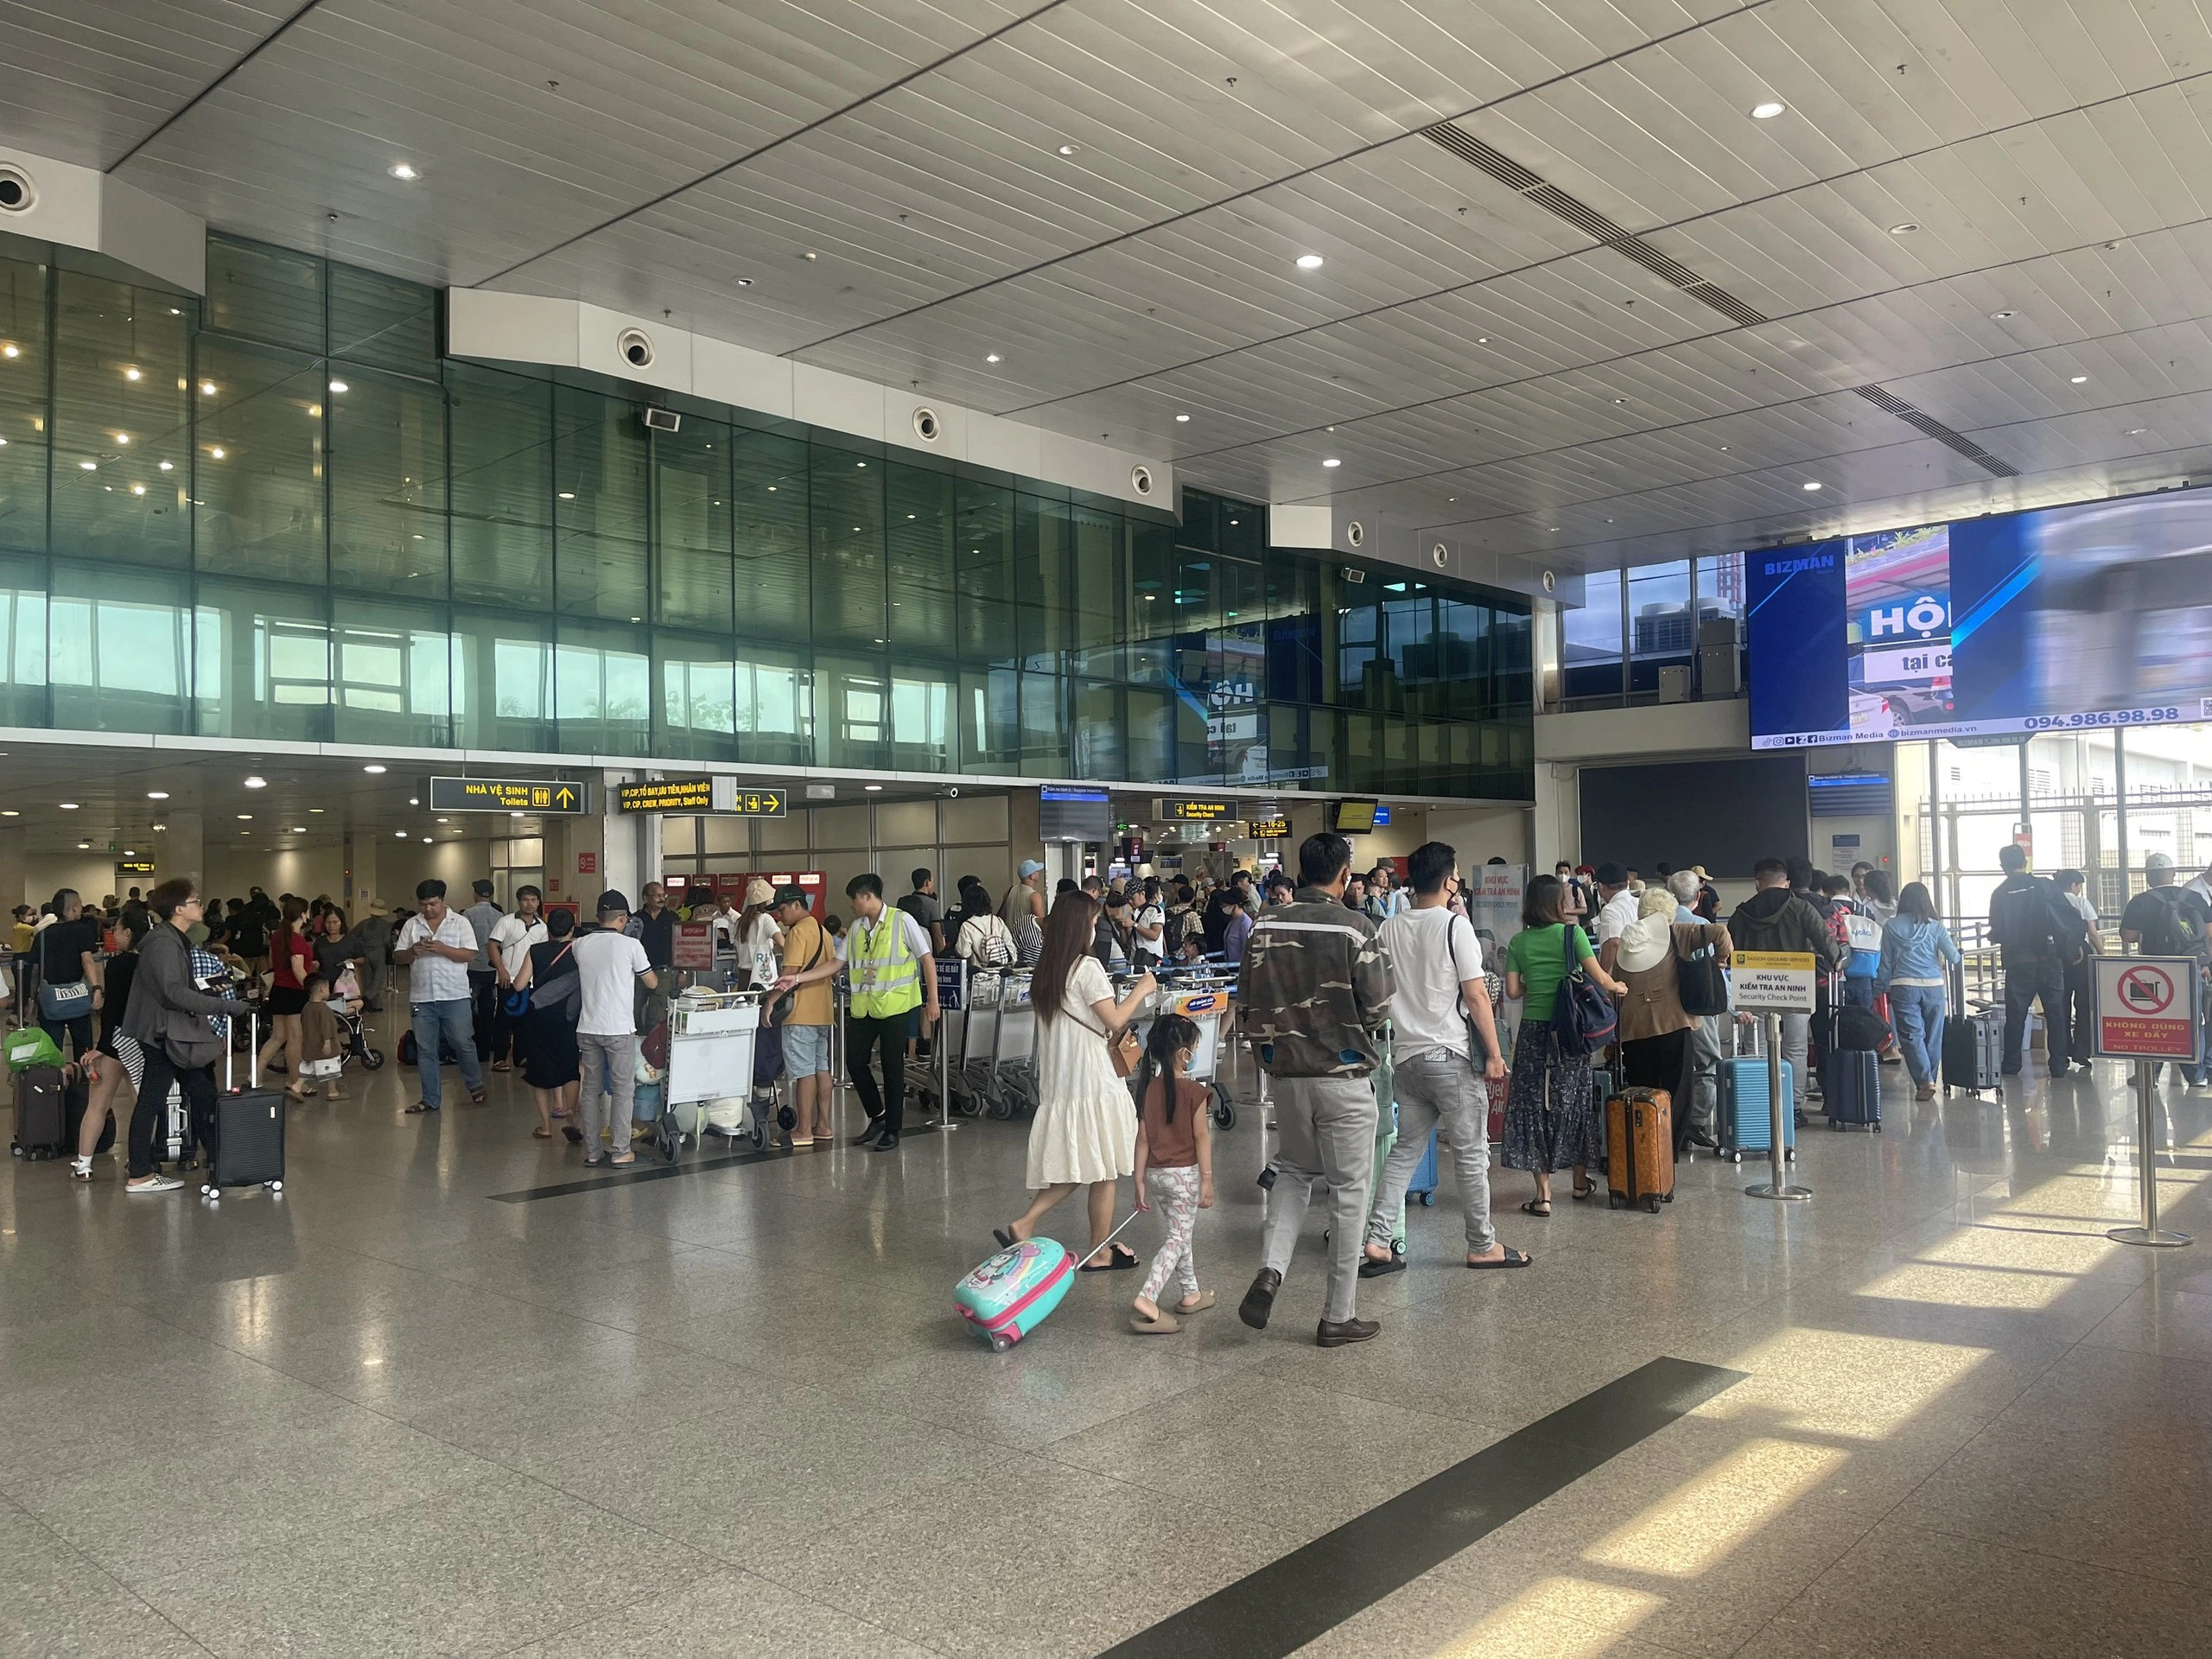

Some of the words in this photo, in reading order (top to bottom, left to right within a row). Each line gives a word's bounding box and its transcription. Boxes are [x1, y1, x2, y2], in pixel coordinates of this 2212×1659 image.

[1764, 555, 1834, 575] BIZMAN
[1902, 654, 1929, 673] tại
[2024, 708, 2179, 729] 094.986.98.98
[1900, 726, 1977, 737] bizmanmedia.vn
[1818, 733, 1853, 743] Bizman
[1855, 731, 1884, 741] Media
[466, 784, 487, 794] NHÀ
[489, 784, 503, 796] VỆ
[505, 786, 528, 796] SINH
[500, 797, 529, 806] Toilets
[1773, 974, 1789, 982] VỰC
[1739, 982, 1758, 990] KIỂM
[1739, 993, 1766, 1001] Security
[1767, 993, 1788, 1001] Check
[1789, 994, 1807, 1002] Point
[2105, 1020, 2146, 1030] KHÔNG
[2133, 1044, 2183, 1052] TROLLEY
